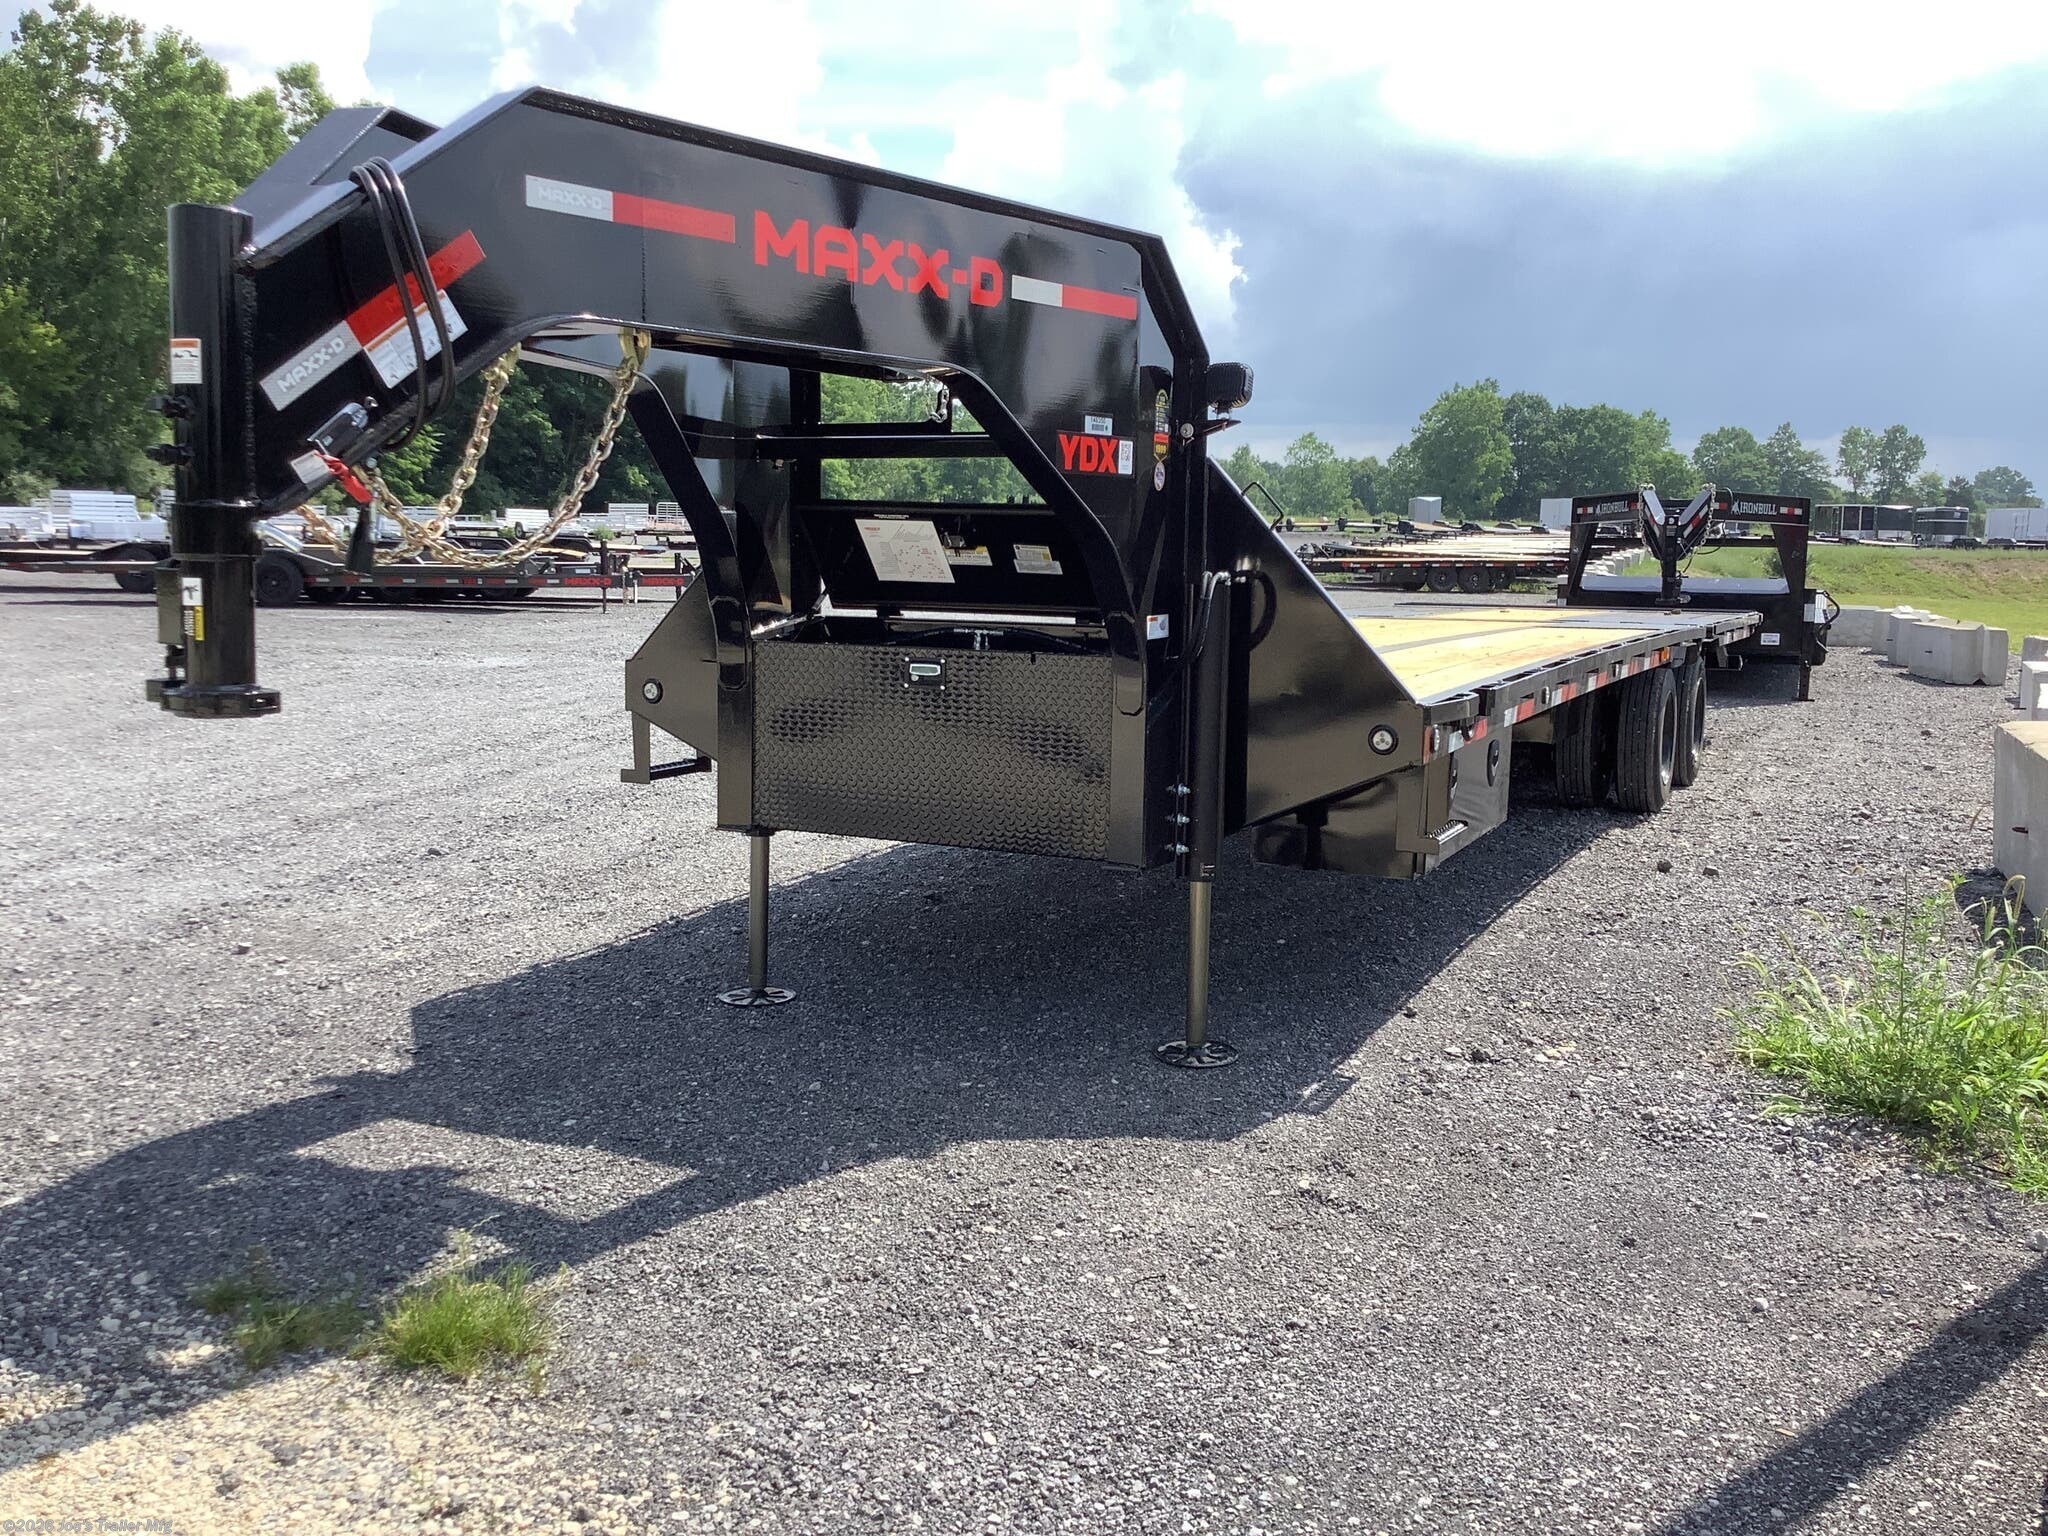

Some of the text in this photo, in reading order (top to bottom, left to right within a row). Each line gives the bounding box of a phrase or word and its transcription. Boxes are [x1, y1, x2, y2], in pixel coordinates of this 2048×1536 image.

[754, 209, 1004, 308] MAXX-D
[276, 335, 346, 393] MAXX-D
[1058, 433, 1119, 474] YDX
